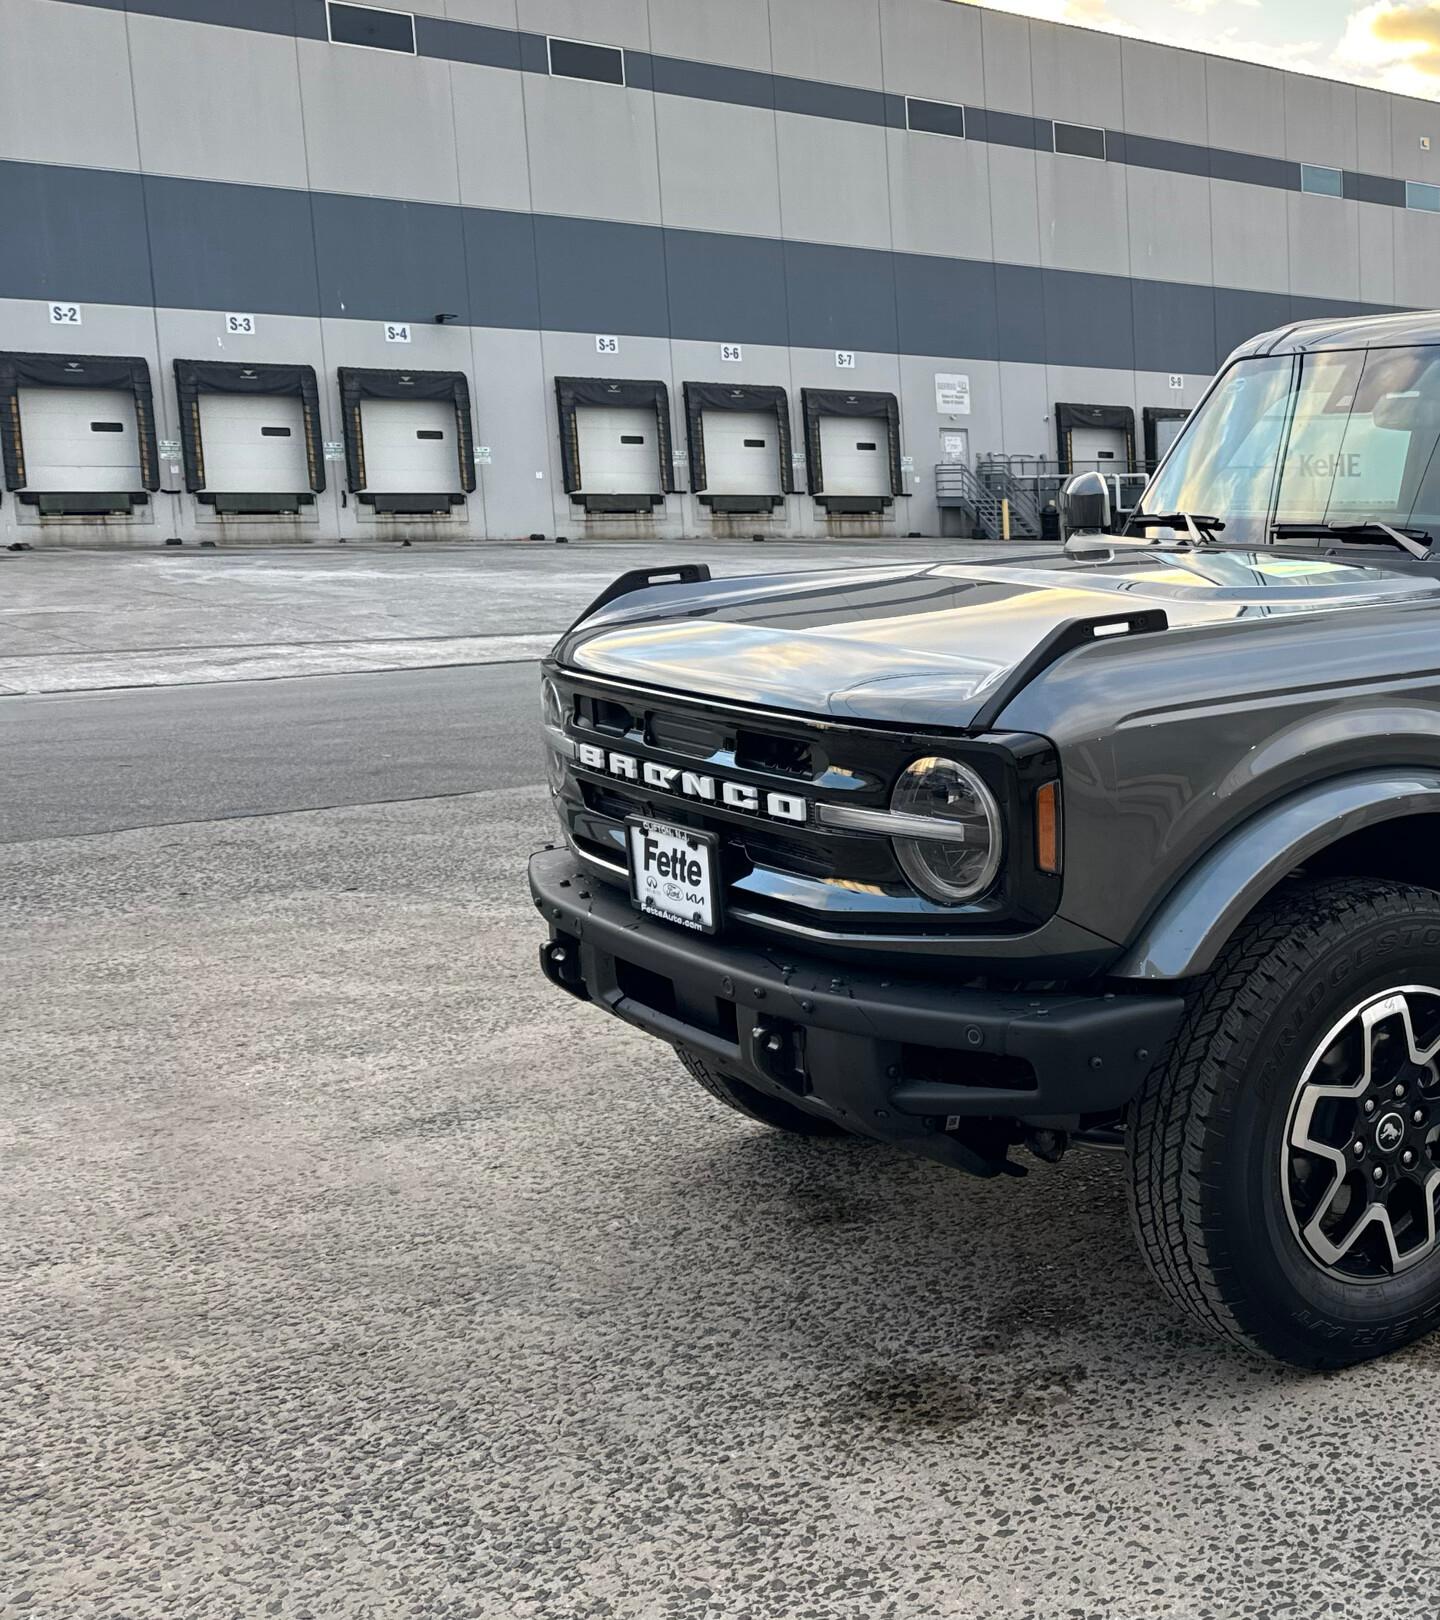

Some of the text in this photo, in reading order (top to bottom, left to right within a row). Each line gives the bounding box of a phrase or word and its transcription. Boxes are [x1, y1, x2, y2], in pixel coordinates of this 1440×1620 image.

[53, 306, 78, 322] S-2
[229, 317, 252, 332] S-3
[387, 326, 408, 341] S-4
[598, 338, 616, 352] S-5
[723, 346, 739, 360] S-6
[837, 354, 852, 366] S-7
[1299, 453, 1362, 477] KeHE
[579, 743, 806, 821] BRONCO
[643, 838, 702, 886] Fette
[641, 905, 702, 931] FetteAuto.com
